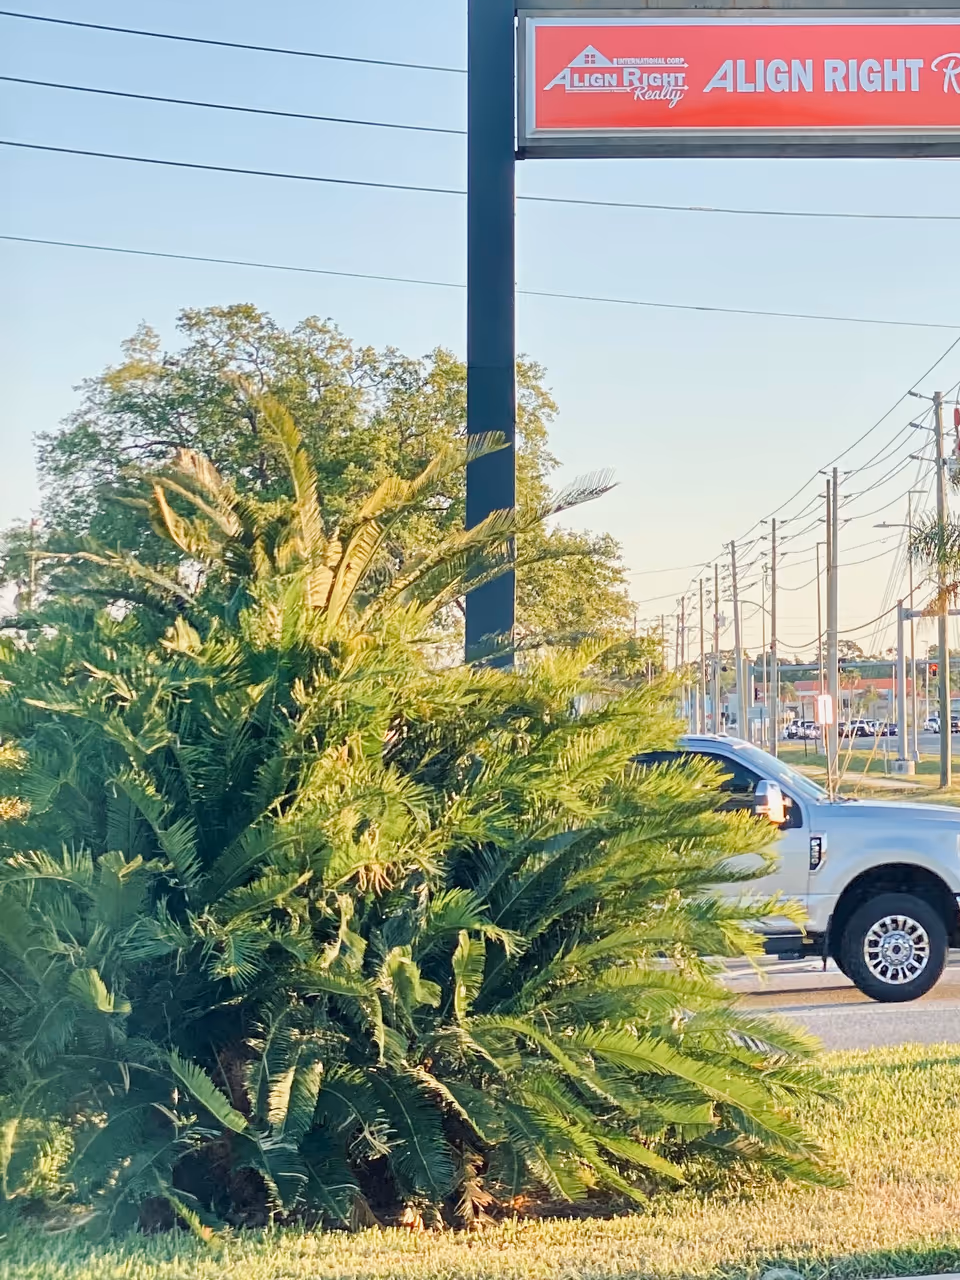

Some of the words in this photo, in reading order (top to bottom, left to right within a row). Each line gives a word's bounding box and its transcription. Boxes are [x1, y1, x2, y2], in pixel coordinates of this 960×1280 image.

[543, 68, 617, 90] ALIGN
[623, 68, 685, 87] RIGHT
[703, 59, 813, 92] ALIGN
[824, 59, 923, 92] RIGHT
[633, 86, 684, 108] Realty
